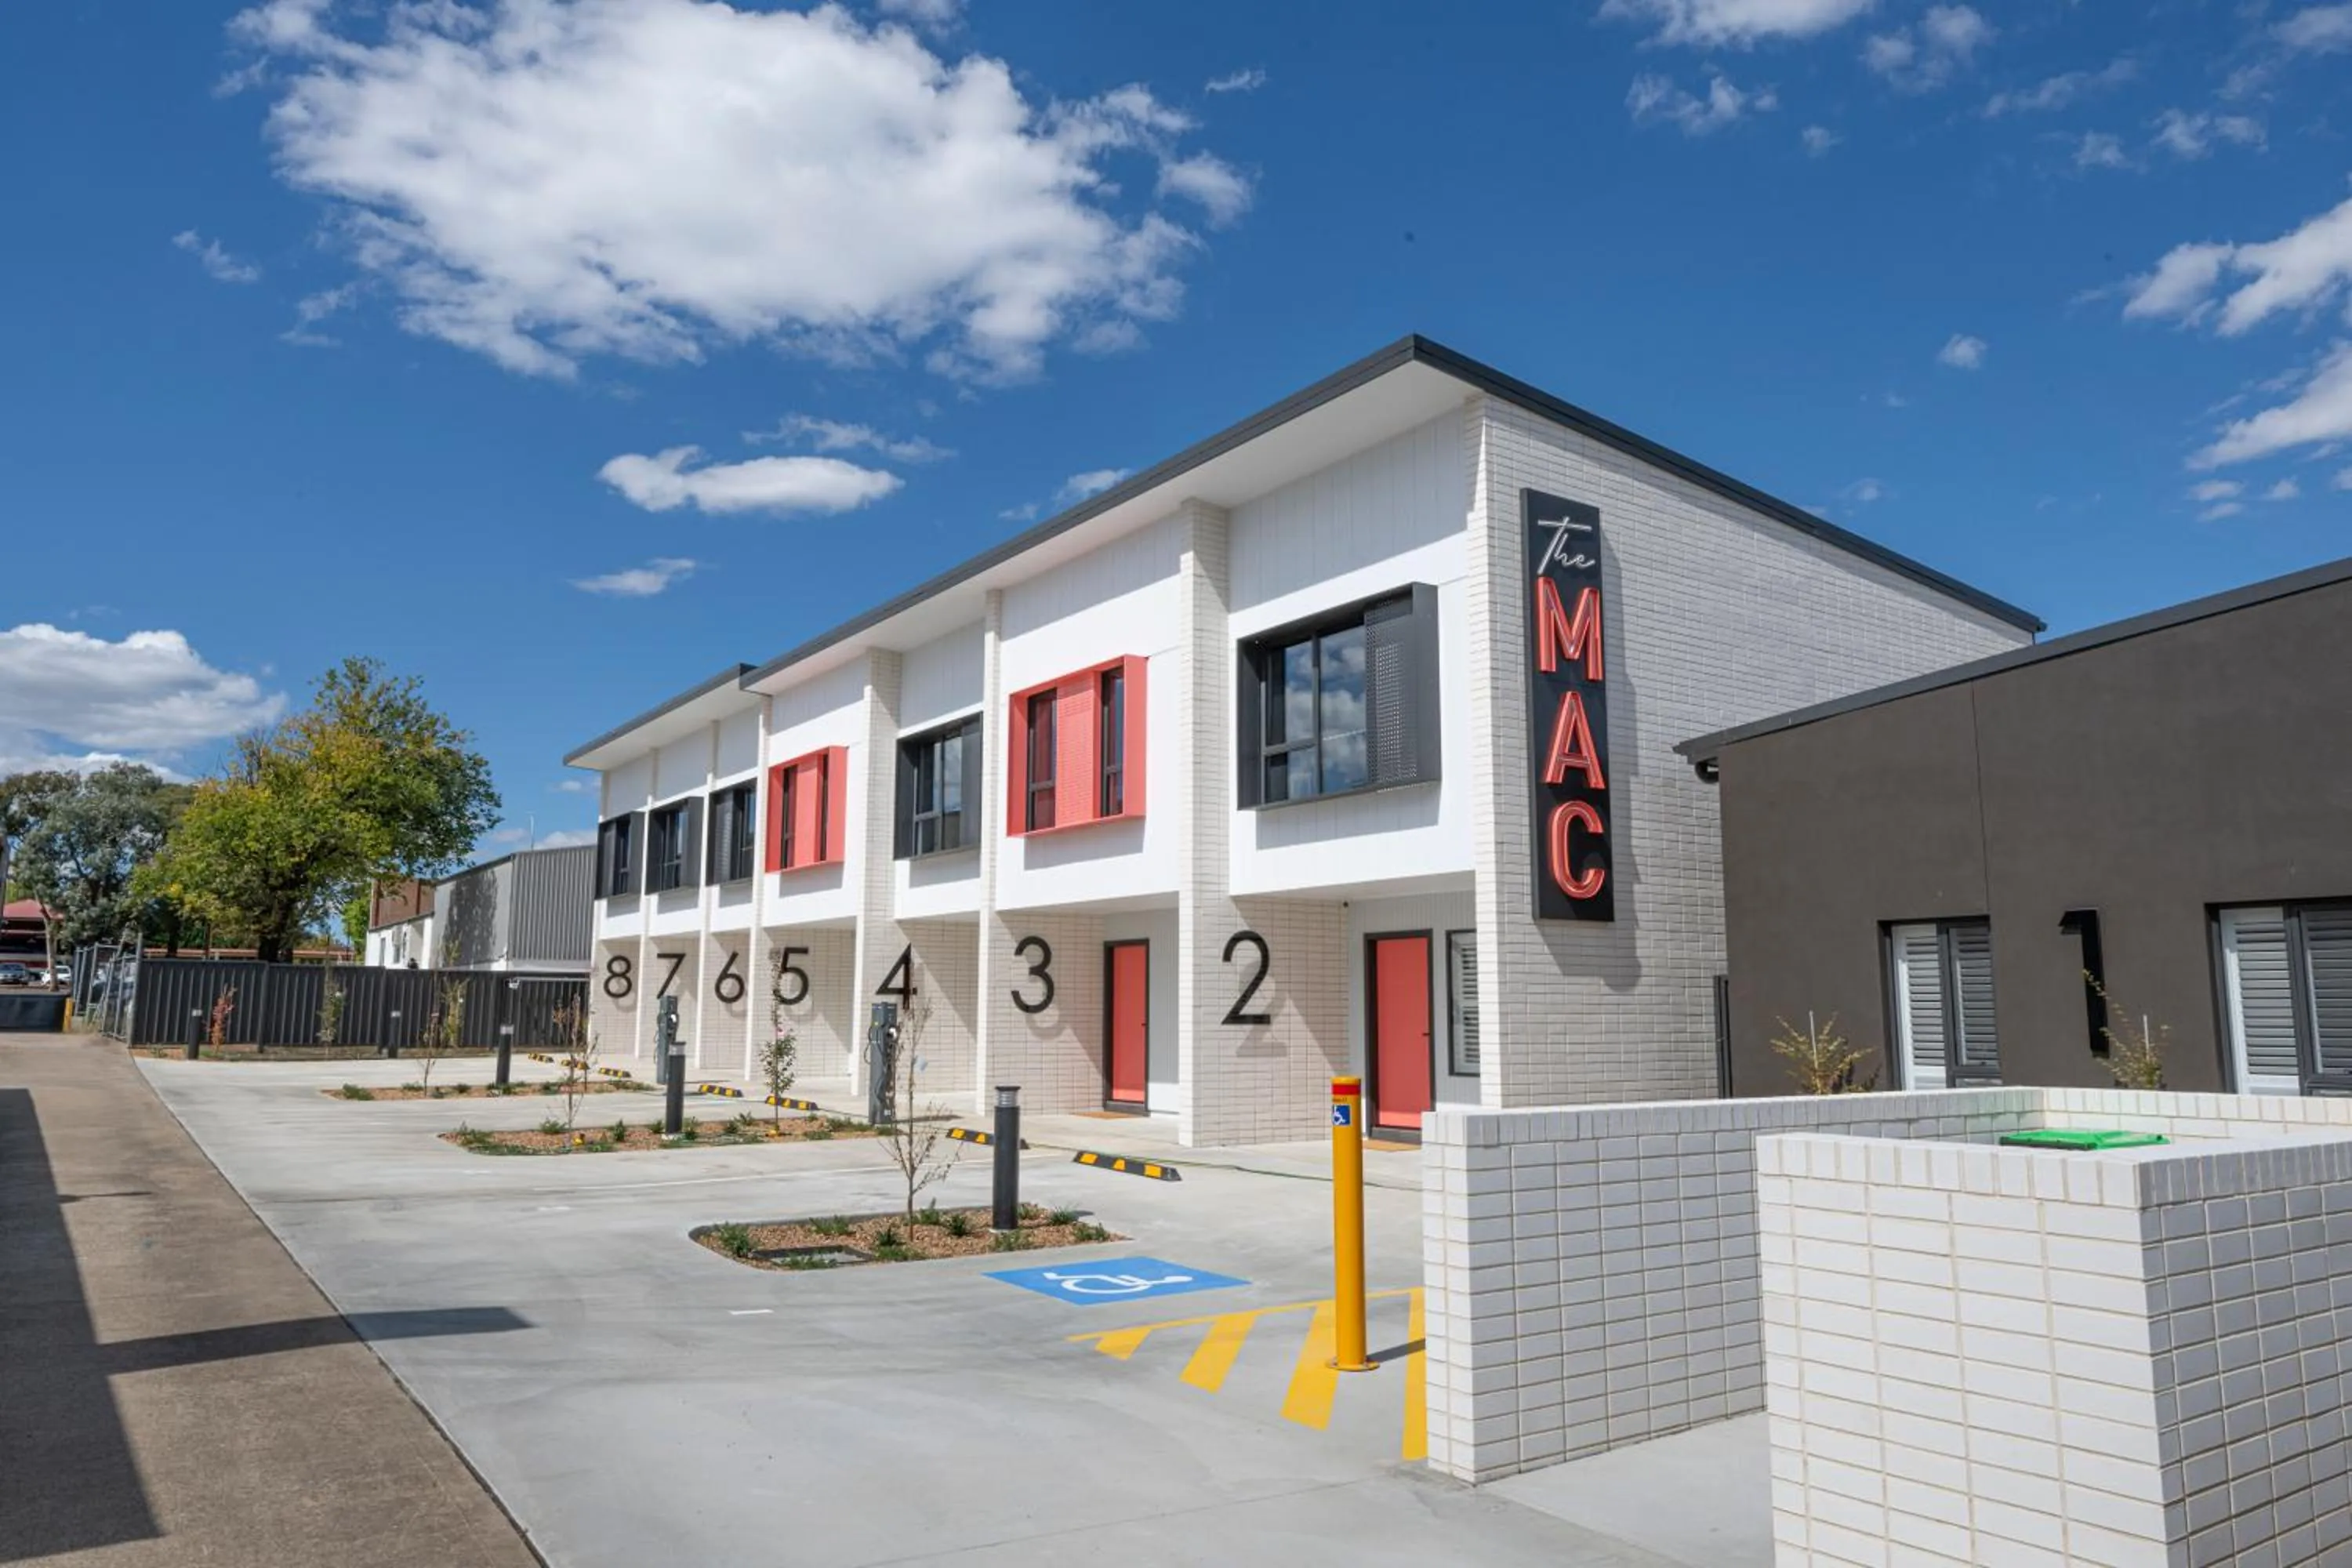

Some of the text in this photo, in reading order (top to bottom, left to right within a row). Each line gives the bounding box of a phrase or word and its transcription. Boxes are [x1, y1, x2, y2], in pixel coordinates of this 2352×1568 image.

[1537, 517, 1595, 575] The
[1537, 576, 1605, 899] MAC
[603, 955, 633, 998] 8
[656, 953, 686, 999] 7
[714, 951, 745, 1004] 6
[774, 946, 809, 1005] 5
[876, 942, 917, 1010] 4
[1011, 936, 1054, 1014] 3
[1221, 930, 1271, 1025] 2
[2059, 908, 2109, 1058] 1
